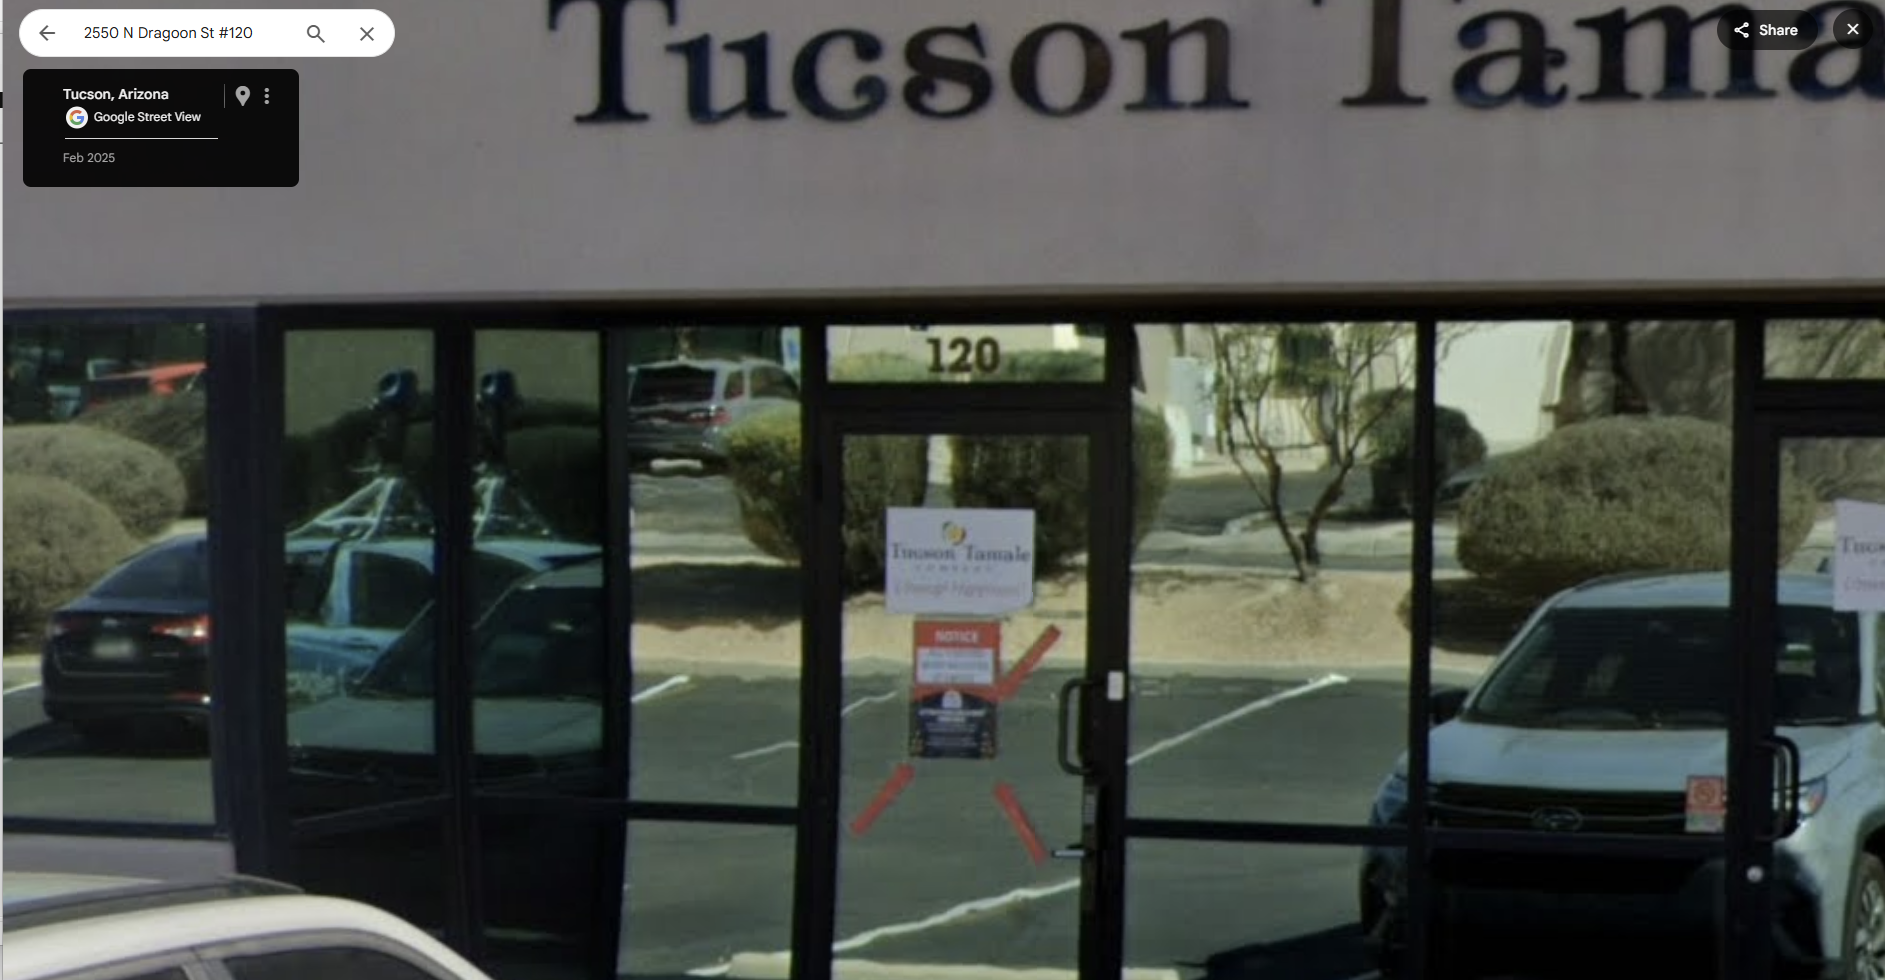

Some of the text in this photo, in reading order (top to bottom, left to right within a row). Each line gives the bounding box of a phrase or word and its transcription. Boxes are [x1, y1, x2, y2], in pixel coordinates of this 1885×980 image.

[547, 0, 1250, 125] Tucson
[926, 336, 1000, 373] 120
[893, 542, 1031, 562] Tucson Tamale
[934, 629, 978, 643] NOTICE
